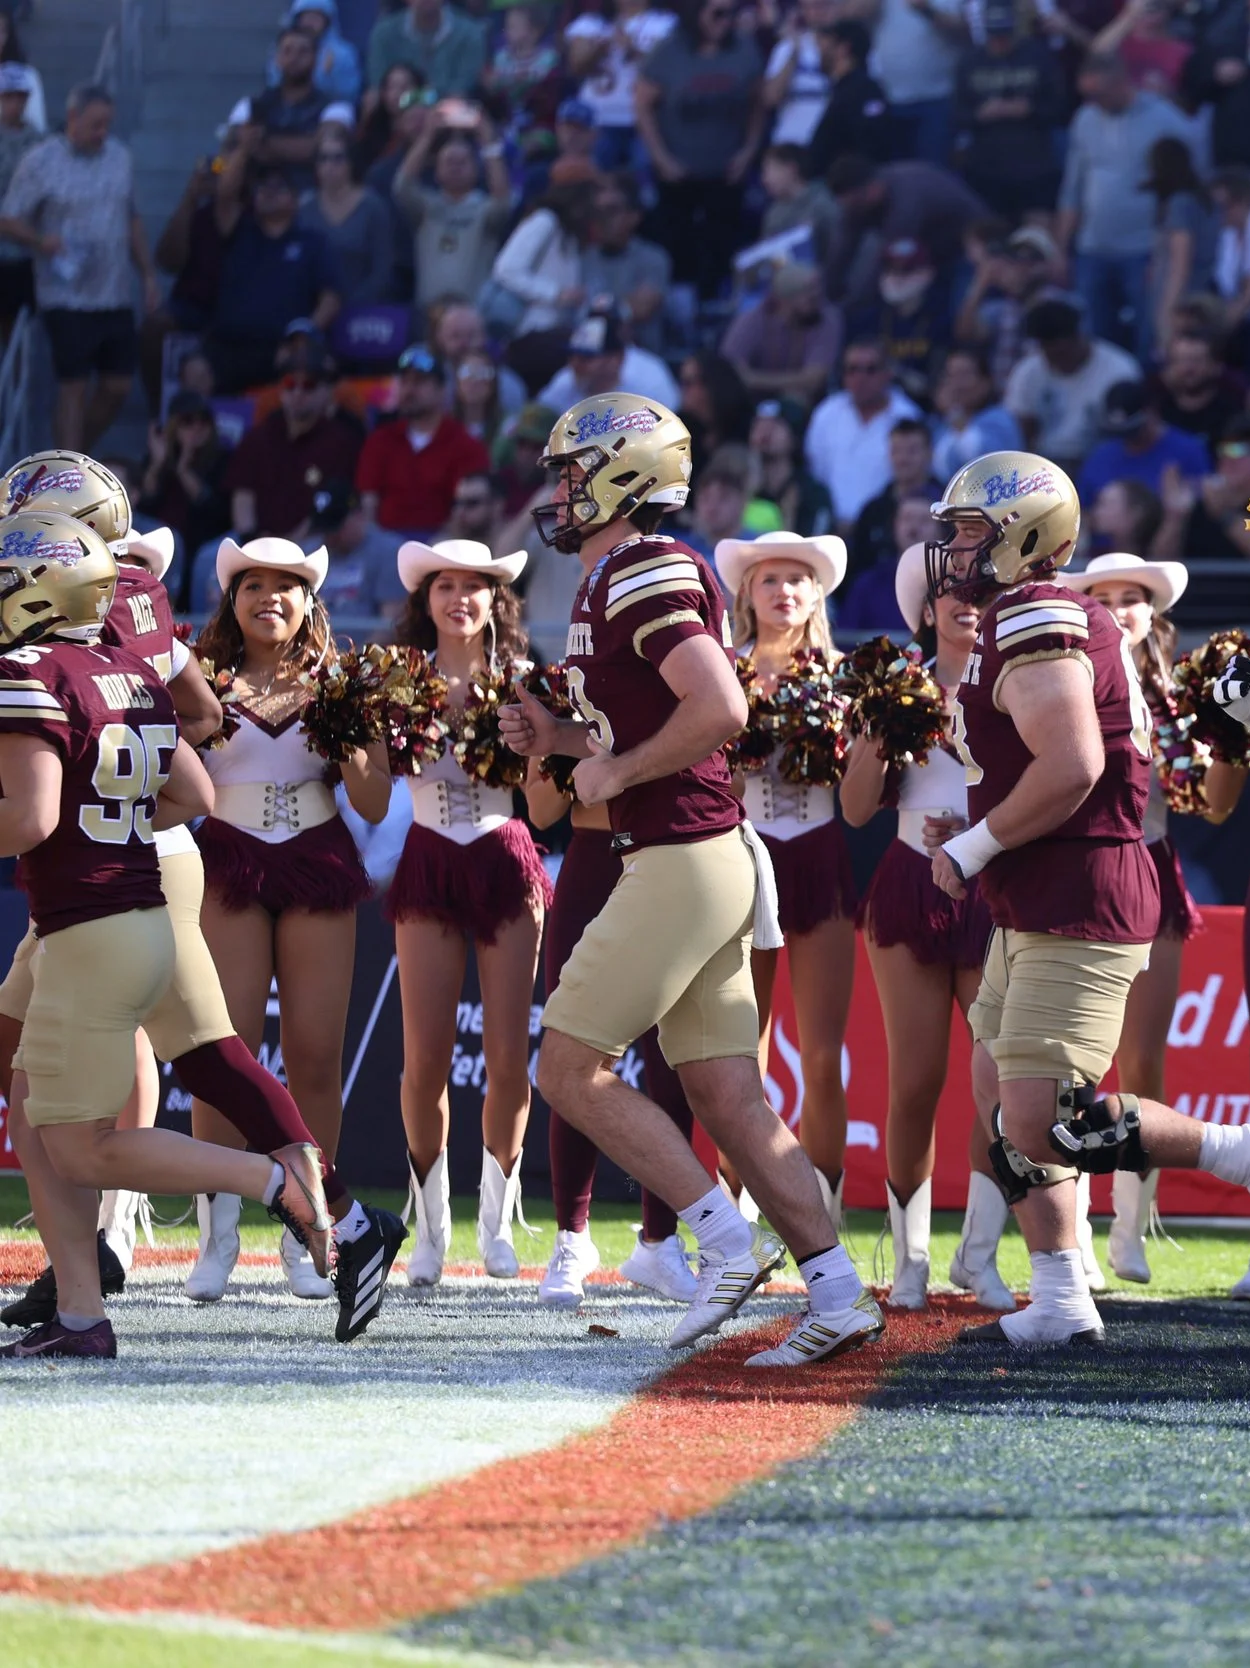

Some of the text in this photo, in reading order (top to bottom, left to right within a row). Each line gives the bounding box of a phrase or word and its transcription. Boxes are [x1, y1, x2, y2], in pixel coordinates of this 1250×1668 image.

[574, 406, 656, 444] Bobcats
[983, 468, 1056, 507] Bobcats
[127, 593, 158, 635] PAGE
[79, 723, 177, 845] 95
